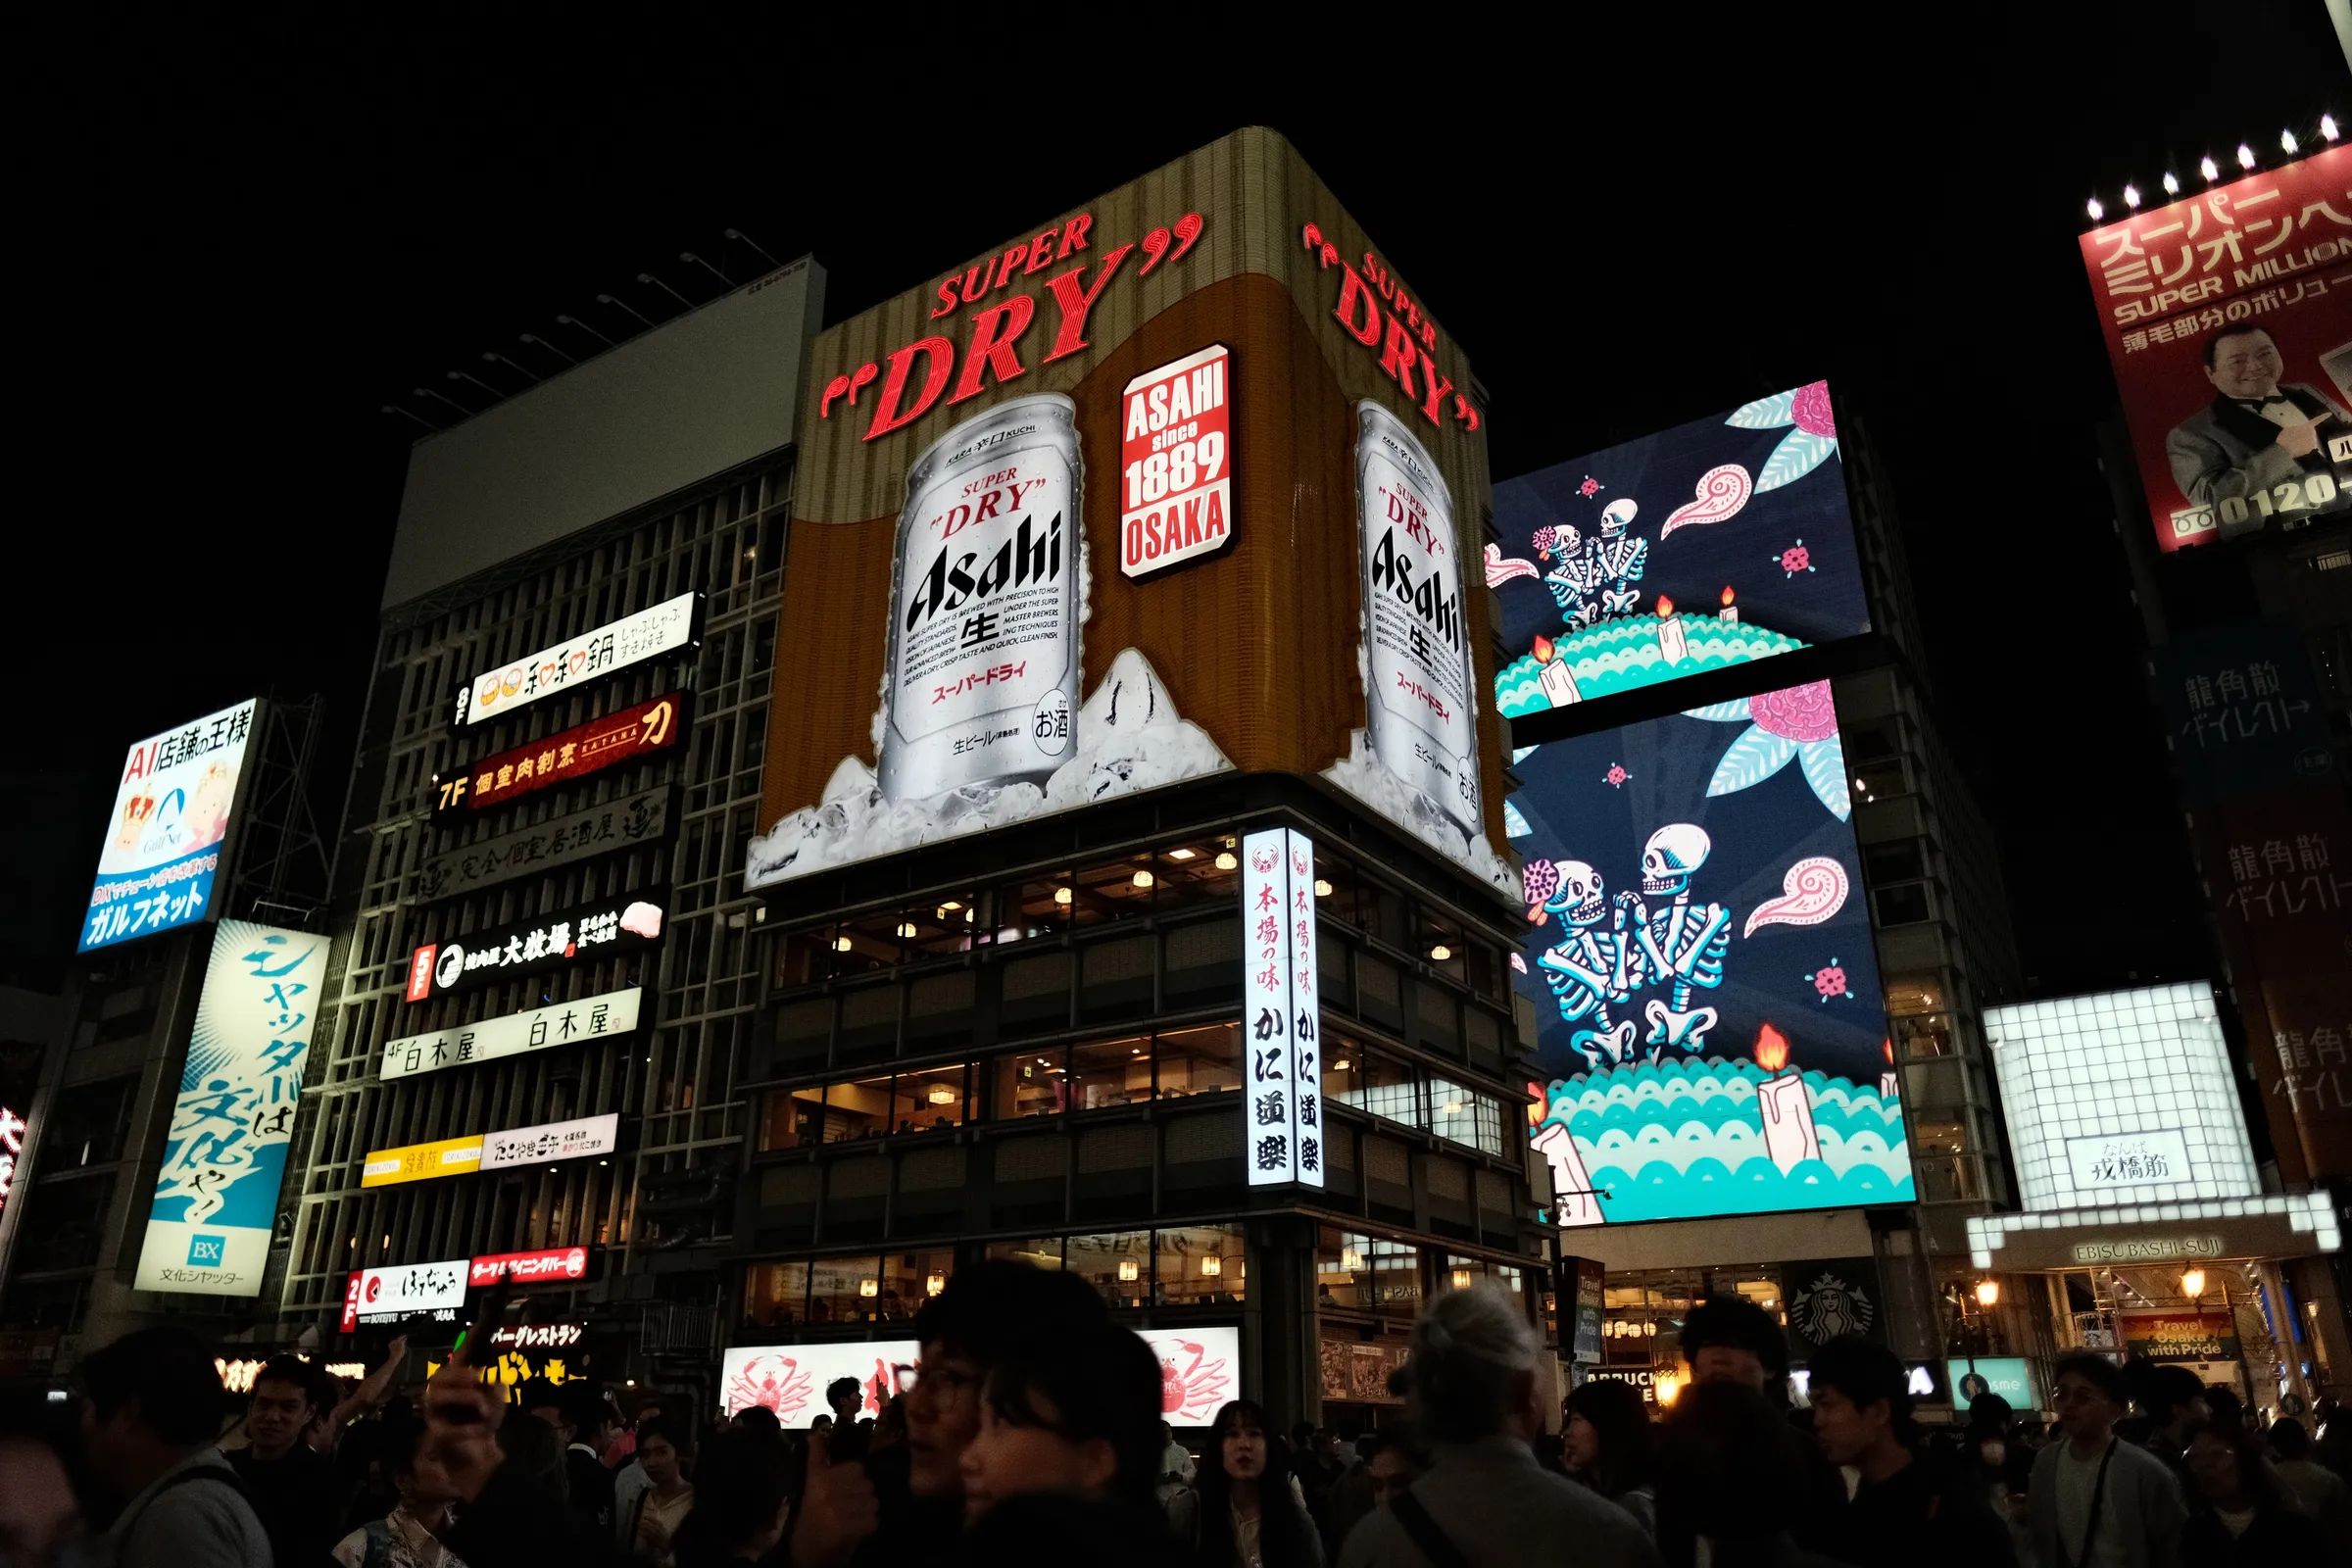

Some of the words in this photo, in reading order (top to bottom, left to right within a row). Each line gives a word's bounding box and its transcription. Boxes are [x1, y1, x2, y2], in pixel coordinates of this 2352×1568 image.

[2094, 189, 2280, 268] スーパー
[2104, 191, 2352, 297] ミリオンヘ
[930, 213, 1094, 319] SUPER
[1362, 252, 1437, 352] SUPER
[2113, 277, 2224, 325] SUPER
[1124, 361, 1225, 443] ASAHI
[947, 448, 972, 466] KARA
[1005, 424, 1036, 438] KUCHI
[1151, 420, 1199, 452] since
[961, 466, 1017, 498] SUPER
[1124, 430, 1226, 511] 1889
[1396, 482, 1428, 521] SUPER
[1125, 489, 1227, 566] OSAKA
[906, 510, 1061, 633] Asahi
[1372, 525, 1460, 653] Asahi
[921, 622, 938, 638] SUPER
[938, 616, 951, 627] DRY
[952, 612, 958, 621] IS
[958, 602, 986, 618] BREWED
[986, 596, 1004, 609] WITH
[1004, 588, 1038, 605] PRECISION
[1038, 587, 1046, 596] TO
[1046, 586, 1059, 595] HIGH
[1003, 613, 1032, 625] MASTER
[1003, 626, 1017, 636] ING
[1017, 620, 1058, 632] TECHNIQUES
[1004, 603, 1028, 613] UNDER
[1028, 600, 1041, 609] THE
[940, 657, 958, 669] CRISP
[958, 648, 979, 662] TASTE
[978, 642, 996, 655] AND
[1019, 632, 1041, 644] CLEAN
[960, 612, 1000, 649] 生
[1409, 624, 1433, 667] 生
[455, 686, 470, 725] 8F
[932, 661, 1026, 705] スーパードライ
[1396, 671, 1450, 725] スーパードライ
[2184, 660, 2283, 712] 龍角散
[124, 707, 252, 785] AI店舗の王様
[1035, 710, 1068, 739] お酒
[2181, 697, 2310, 750] ダイレクト
[439, 777, 468, 810] 7F
[475, 743, 577, 796] 個室肉割烹
[638, 701, 672, 745] 刀
[461, 812, 615, 882] 完全個室居酒屋
[2228, 832, 2331, 882] 龍角散
[85, 881, 204, 946] ガルフネット
[499, 922, 571, 967] 大牧場
[1253, 882, 1280, 994] 本場の味
[1294, 884, 1311, 997] 本場の味
[413, 950, 430, 997] 5F
[388, 1042, 404, 1058] 4F
[404, 1032, 475, 1073] 白木屋
[528, 1004, 610, 1048] 白木屋
[2088, 1153, 2170, 1183] 戎橋筋
[2103, 1140, 2148, 1156] なんば
[194, 1242, 220, 1260] BX
[2076, 1246, 2125, 1261] EBISU
[159, 1267, 245, 1286] 文化シャッター
[1580, 1276, 1600, 1292] Travel
[343, 1278, 361, 1325] 2F
[1582, 1307, 1595, 1321] with
[1580, 1322, 1596, 1336] Pride
[2153, 1319, 2203, 1332] Travel
[2155, 1331, 2207, 1344] Osaka
[2146, 1344, 2180, 1357] with
[2181, 1343, 2222, 1356] Pride
